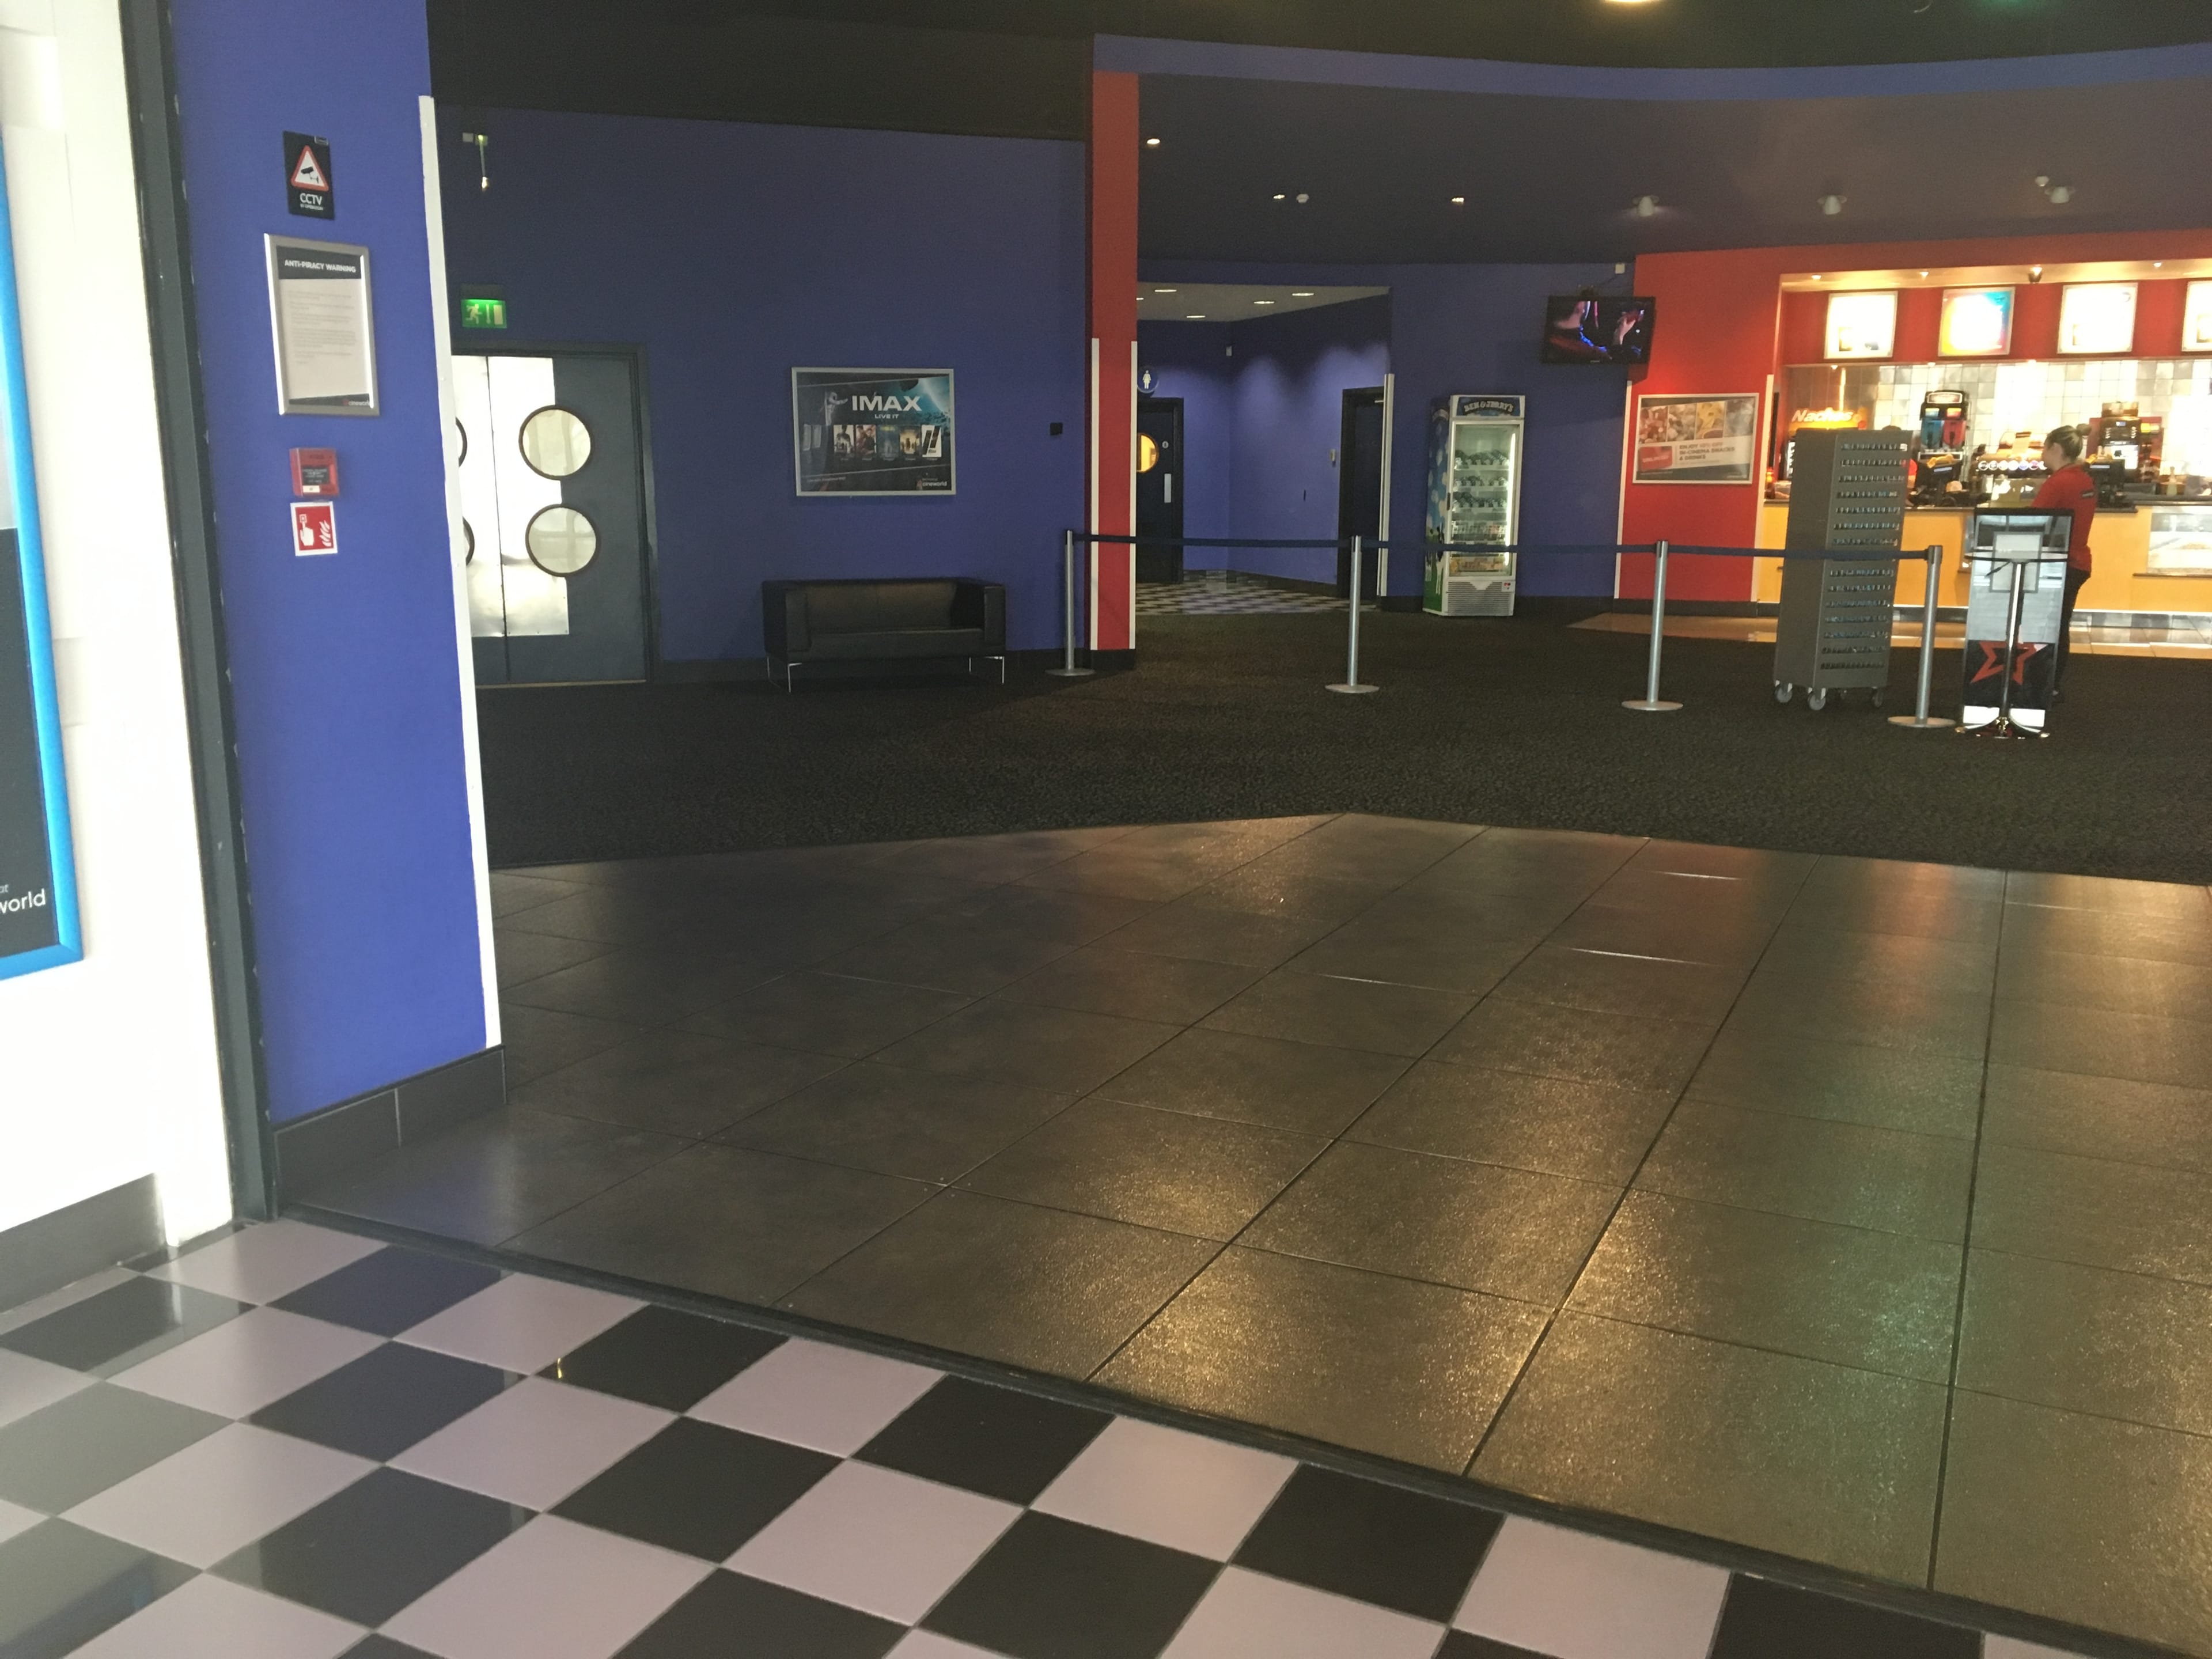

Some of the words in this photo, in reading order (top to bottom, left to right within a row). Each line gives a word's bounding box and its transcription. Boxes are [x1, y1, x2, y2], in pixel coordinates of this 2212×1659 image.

[300, 192, 323, 205] CCTV
[285, 259, 324, 270] ANTI-PIRACY
[325, 263, 356, 272] WARNING
[852, 395, 922, 411] IMAX
[1791, 407, 1854, 422] Nachos
